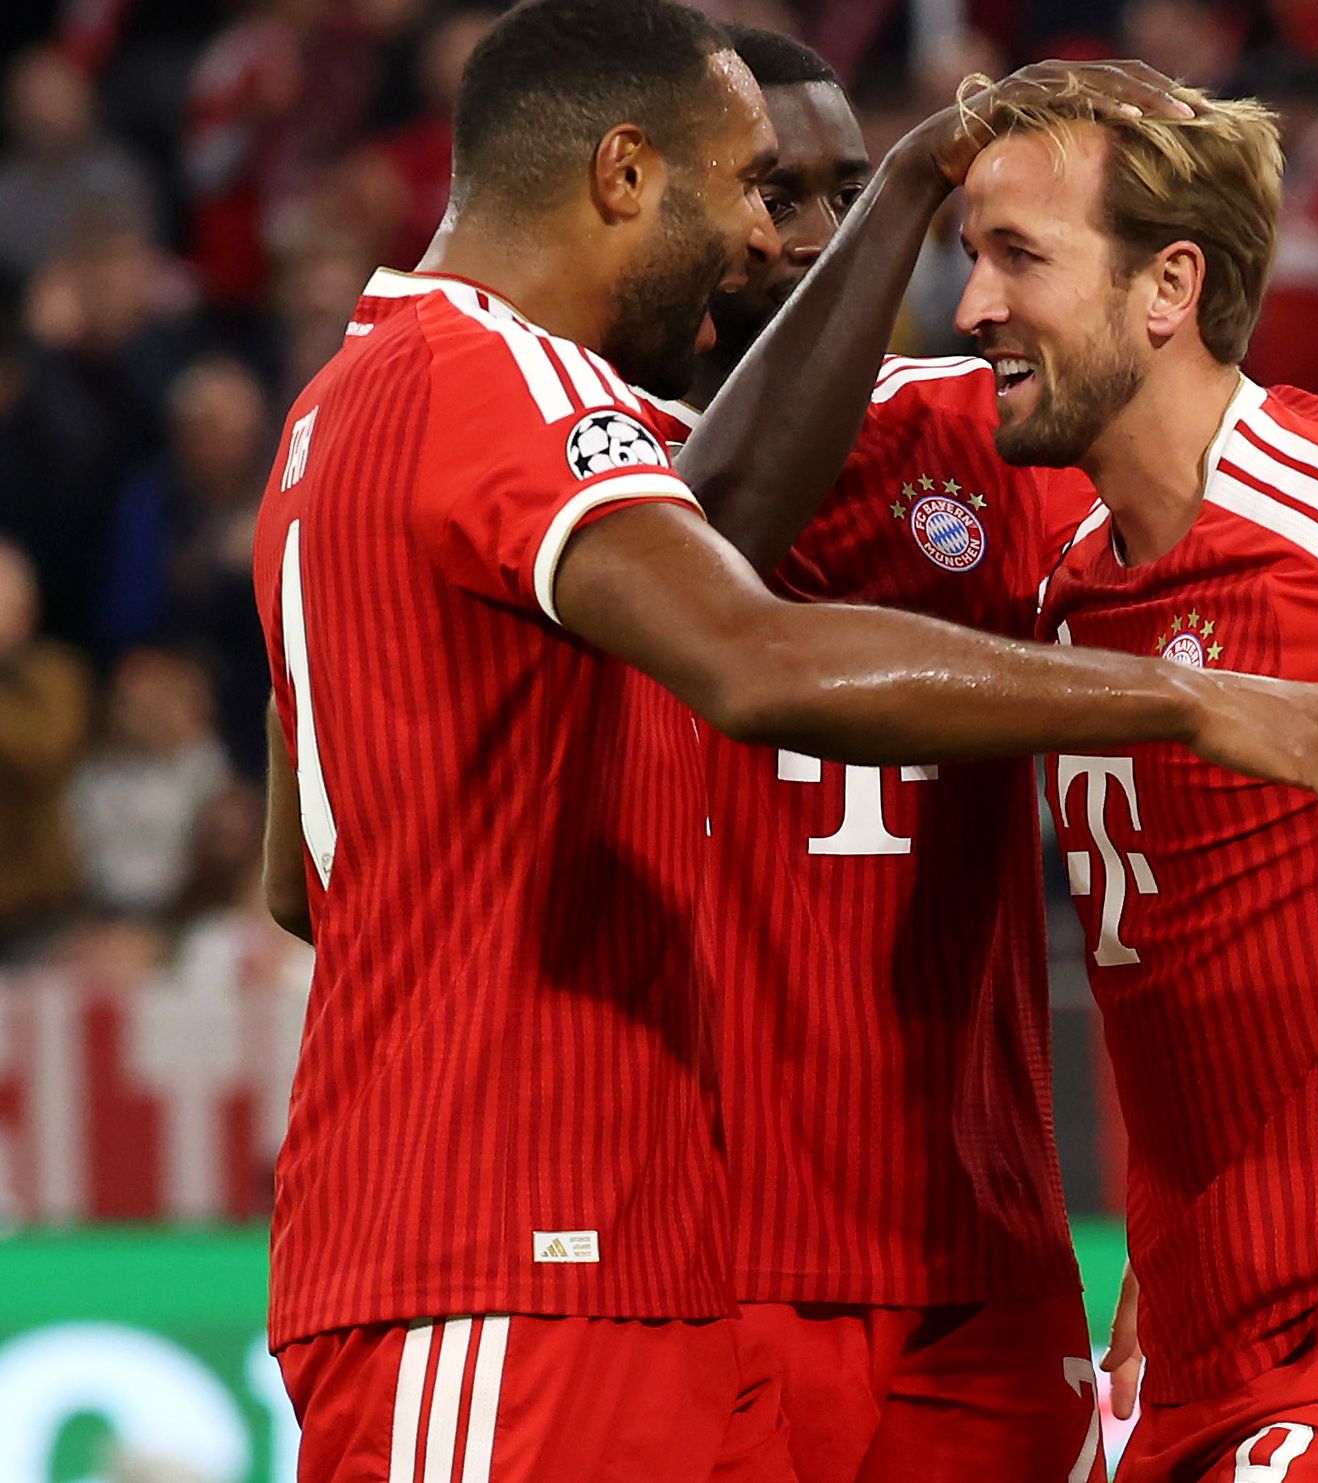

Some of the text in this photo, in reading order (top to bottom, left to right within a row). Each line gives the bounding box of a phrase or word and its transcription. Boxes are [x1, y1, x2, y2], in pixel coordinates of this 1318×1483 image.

[915, 501, 975, 531] FC BAYERN
[1057, 754, 1159, 967] T
